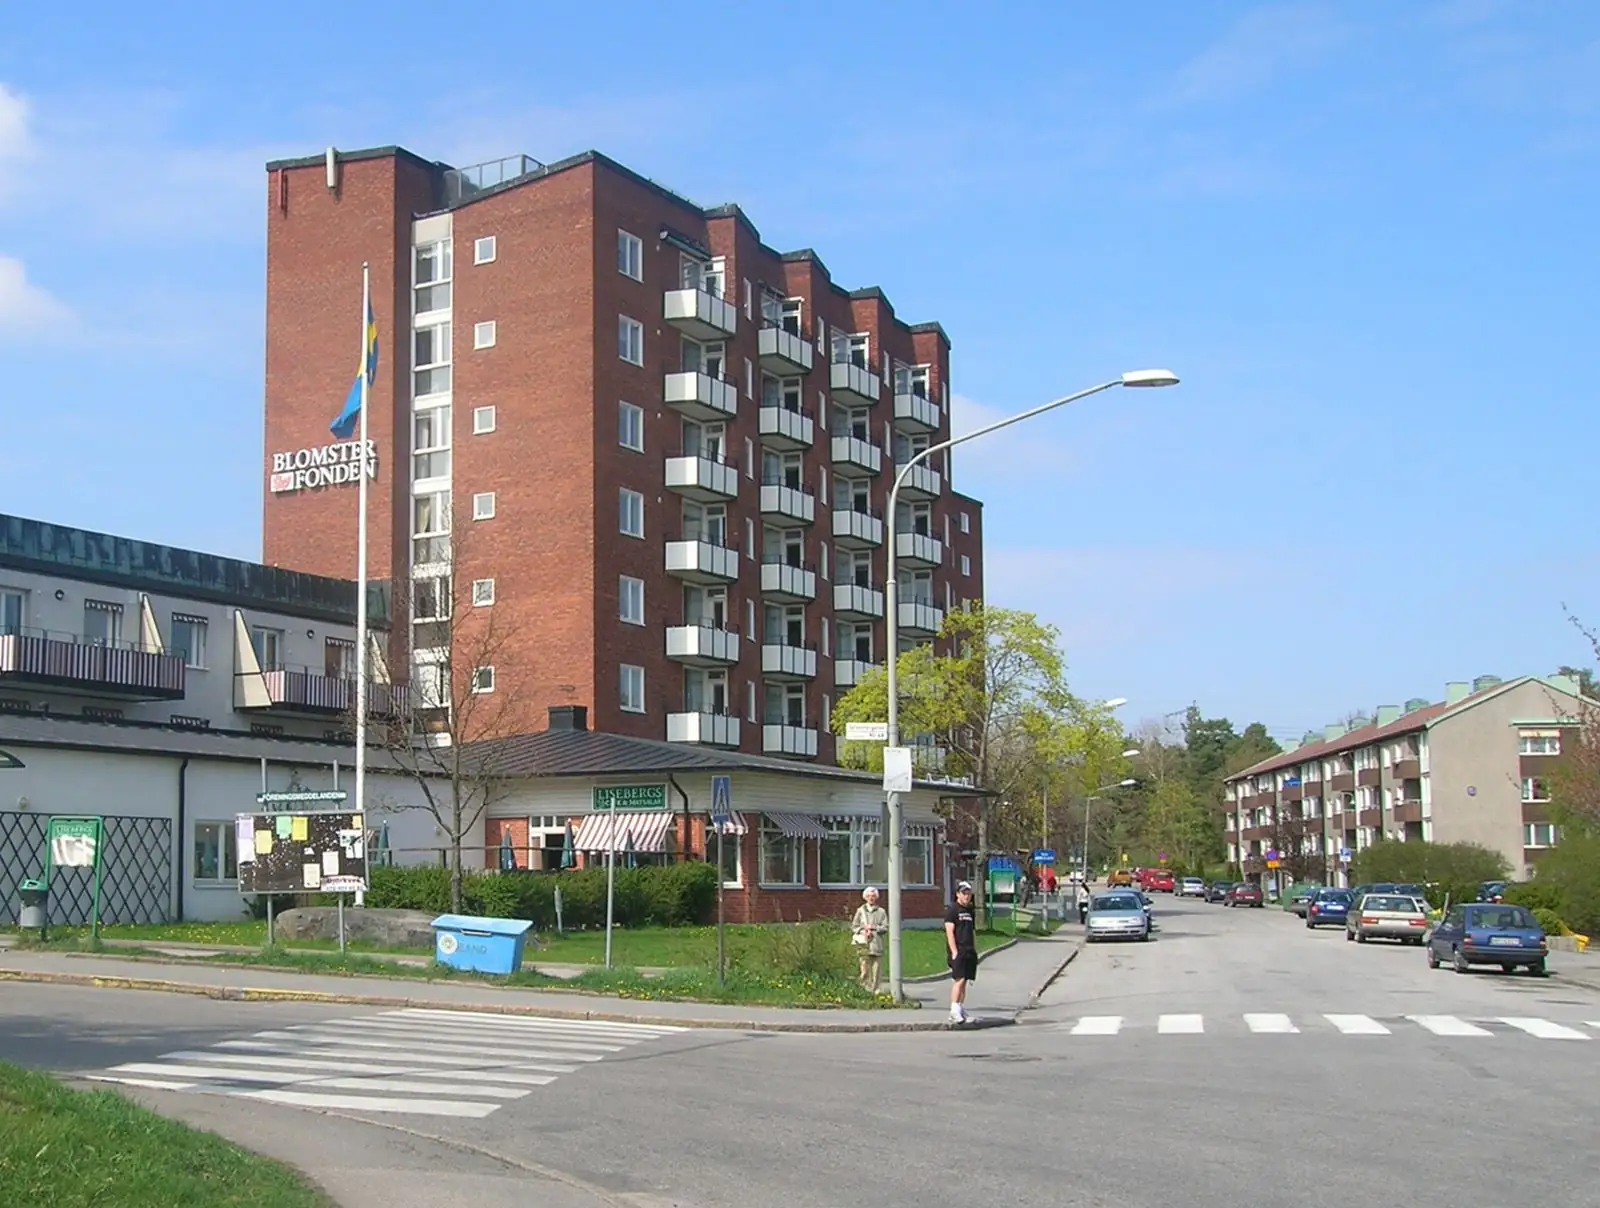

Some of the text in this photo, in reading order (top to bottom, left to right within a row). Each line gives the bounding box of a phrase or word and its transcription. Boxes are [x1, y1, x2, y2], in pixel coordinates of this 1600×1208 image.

[272, 439, 376, 473] BLOMSTER
[294, 459, 376, 490] FONDEN
[598, 787, 662, 800] LISEBERGS
